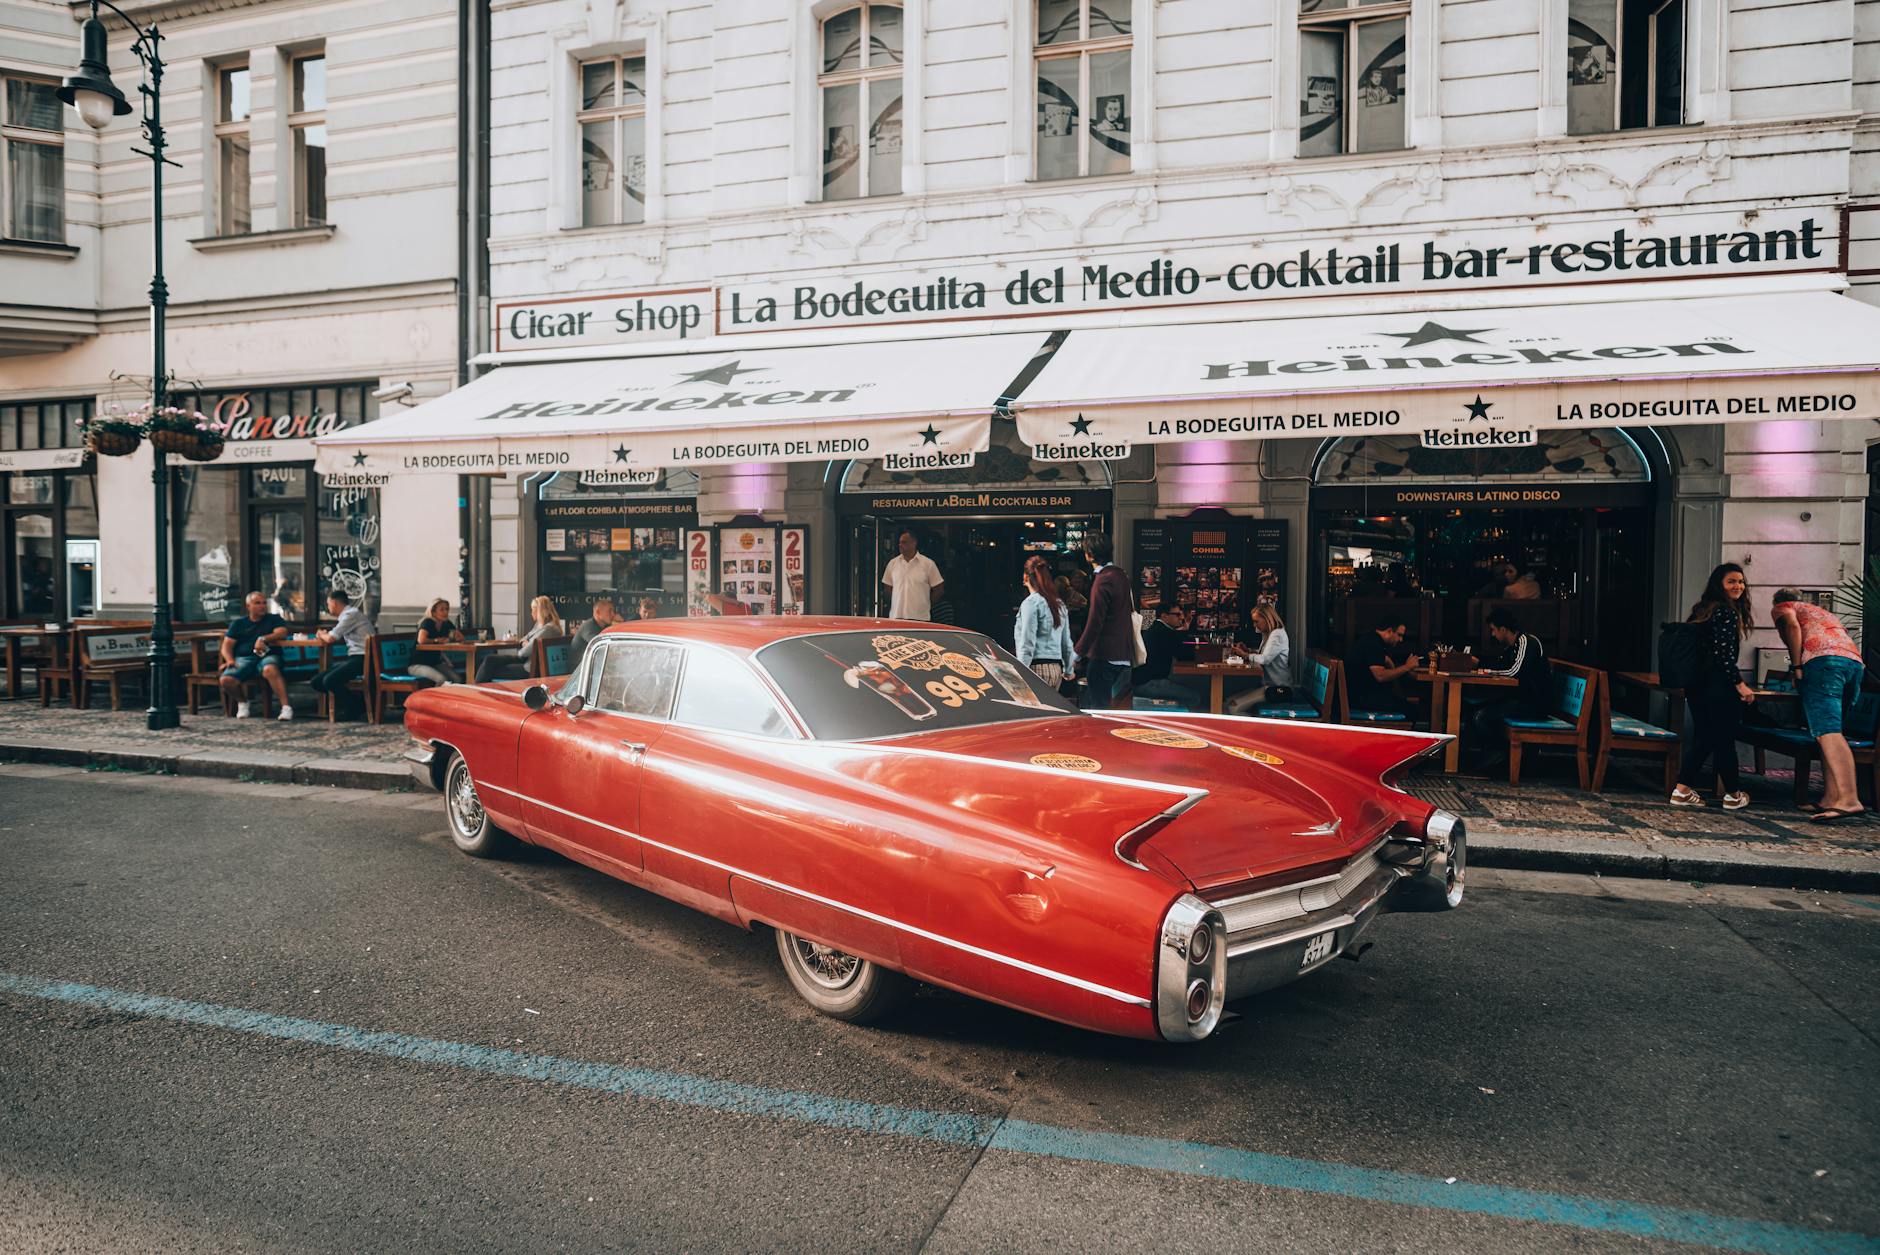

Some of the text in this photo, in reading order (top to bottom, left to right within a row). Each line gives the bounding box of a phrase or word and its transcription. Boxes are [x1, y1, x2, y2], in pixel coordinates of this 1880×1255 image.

[731, 292, 777, 325] La
[793, 276, 986, 320] Bodeguita
[1005, 266, 1065, 305] del
[1422, 218, 1823, 281] bar-restaurant
[510, 299, 701, 340] Cigar shop
[1200, 341, 1756, 380] Heineken
[476, 388, 860, 421] Heineken
[1557, 394, 1857, 420] LA BODEGUITA DEL MEDIO
[213, 391, 348, 440] Paneria
[1148, 410, 1400, 435] LA BODEGUITA DEL MEDIO
[1423, 427, 1532, 447] Heineken
[233, 446, 273, 458] COFFEE
[672, 438, 870, 460] LA BODEGUITA DEL MEDIO
[1035, 442, 1126, 460] Heineken
[404, 451, 570, 468] LA BODEGUITA DEL MEDIO
[885, 451, 971, 470] Heineken
[261, 468, 297, 482] PAUL
[327, 472, 390, 486] Heineken
[584, 468, 656, 483] Heineken
[872, 498, 934, 508] RESTAURANT
[992, 496, 1048, 507] COCKTAILS
[1050, 496, 1072, 506] BAR
[1397, 489, 1561, 502] DOWNSTAIRS LATINO DISCO
[559, 506, 585, 516] FLOOR
[587, 506, 617, 515] COHIBA
[618, 505, 673, 514] ATMOSPHERE
[674, 504, 692, 513] BAR
[691, 532, 707, 557] 2
[785, 531, 800, 556] 2
[691, 558, 707, 570] GO
[785, 557, 801, 570] GO
[883, 646, 908, 661] TAKE
